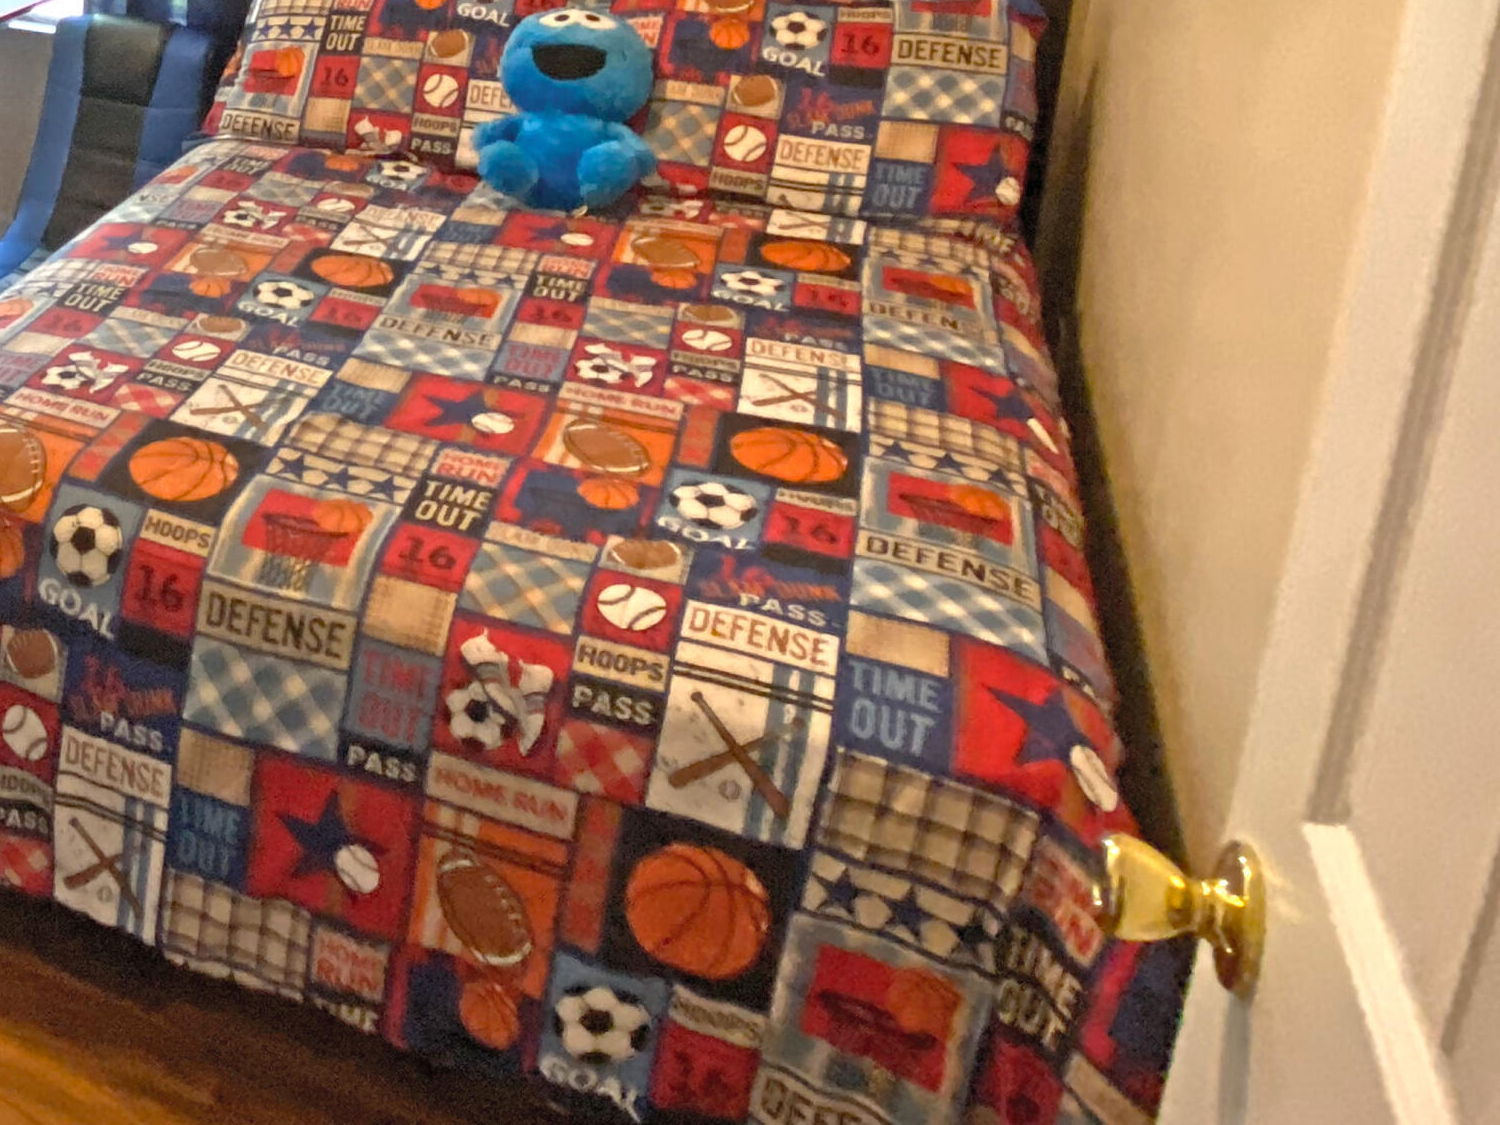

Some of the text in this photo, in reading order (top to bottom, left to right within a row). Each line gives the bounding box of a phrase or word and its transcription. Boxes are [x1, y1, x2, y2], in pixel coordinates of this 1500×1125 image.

[331, 15, 366, 31] TIME
[457, 3, 510, 26] GOAL
[326, 33, 360, 50] OUT
[842, 35, 879, 56] 16
[898, 40, 1002, 68] DEFENSE
[762, 46, 825, 76] GOAL
[323, 67, 349, 86] 16
[221, 114, 295, 140] DEFENSE
[812, 122, 864, 139] PASS
[411, 138, 450, 154] PASS
[780, 141, 864, 170] DEFENSE
[876, 163, 924, 184] TIME
[872, 186, 922, 208] OUT
[75, 282, 128, 301] TIME
[533, 287, 580, 303] OUT
[536, 275, 587, 292] TIME
[64, 293, 110, 312] OUT
[238, 301, 299, 326] GOAL
[532, 306, 573, 322] 16
[711, 289, 790, 312] GOAL
[380, 317, 494, 347] DEFENSE
[272, 347, 330, 366] PASS
[504, 358, 557, 375] OUT
[509, 344, 562, 361] TIME
[136, 372, 189, 391] PASS
[232, 352, 323, 385] DEFENSE
[332, 383, 386, 405] TIME
[494, 376, 550, 392] PASS
[875, 382, 931, 405] OUT
[15, 391, 110, 422] HOME RUN
[322, 395, 379, 420] OUT
[566, 386, 676, 414] HOME RUN
[425, 480, 493, 509] TIME
[415, 500, 481, 531] OUT
[144, 515, 212, 550] HOOPS
[656, 516, 754, 550] GOAL
[398, 536, 457, 570] 16
[867, 538, 1034, 602] DEFENSE
[140, 565, 184, 613] 16
[37, 577, 114, 640] GOAL
[740, 593, 827, 627] PASS
[205, 592, 347, 658] DEFENSE
[689, 606, 830, 666] DEFENSE
[577, 643, 664, 681] HOOPS
[848, 659, 942, 712] TIME
[572, 685, 652, 725] PASS
[101, 712, 164, 753] PASS
[850, 700, 938, 757] OUT
[66, 738, 165, 806] DEFENSE
[348, 745, 417, 782] PASS
[435, 767, 568, 821] HOME RUN
[180, 800, 241, 837] TIME
[179, 835, 231, 875] OUT
[999, 977, 1069, 1051] OUT
[540, 1055, 640, 1123] GOAL
